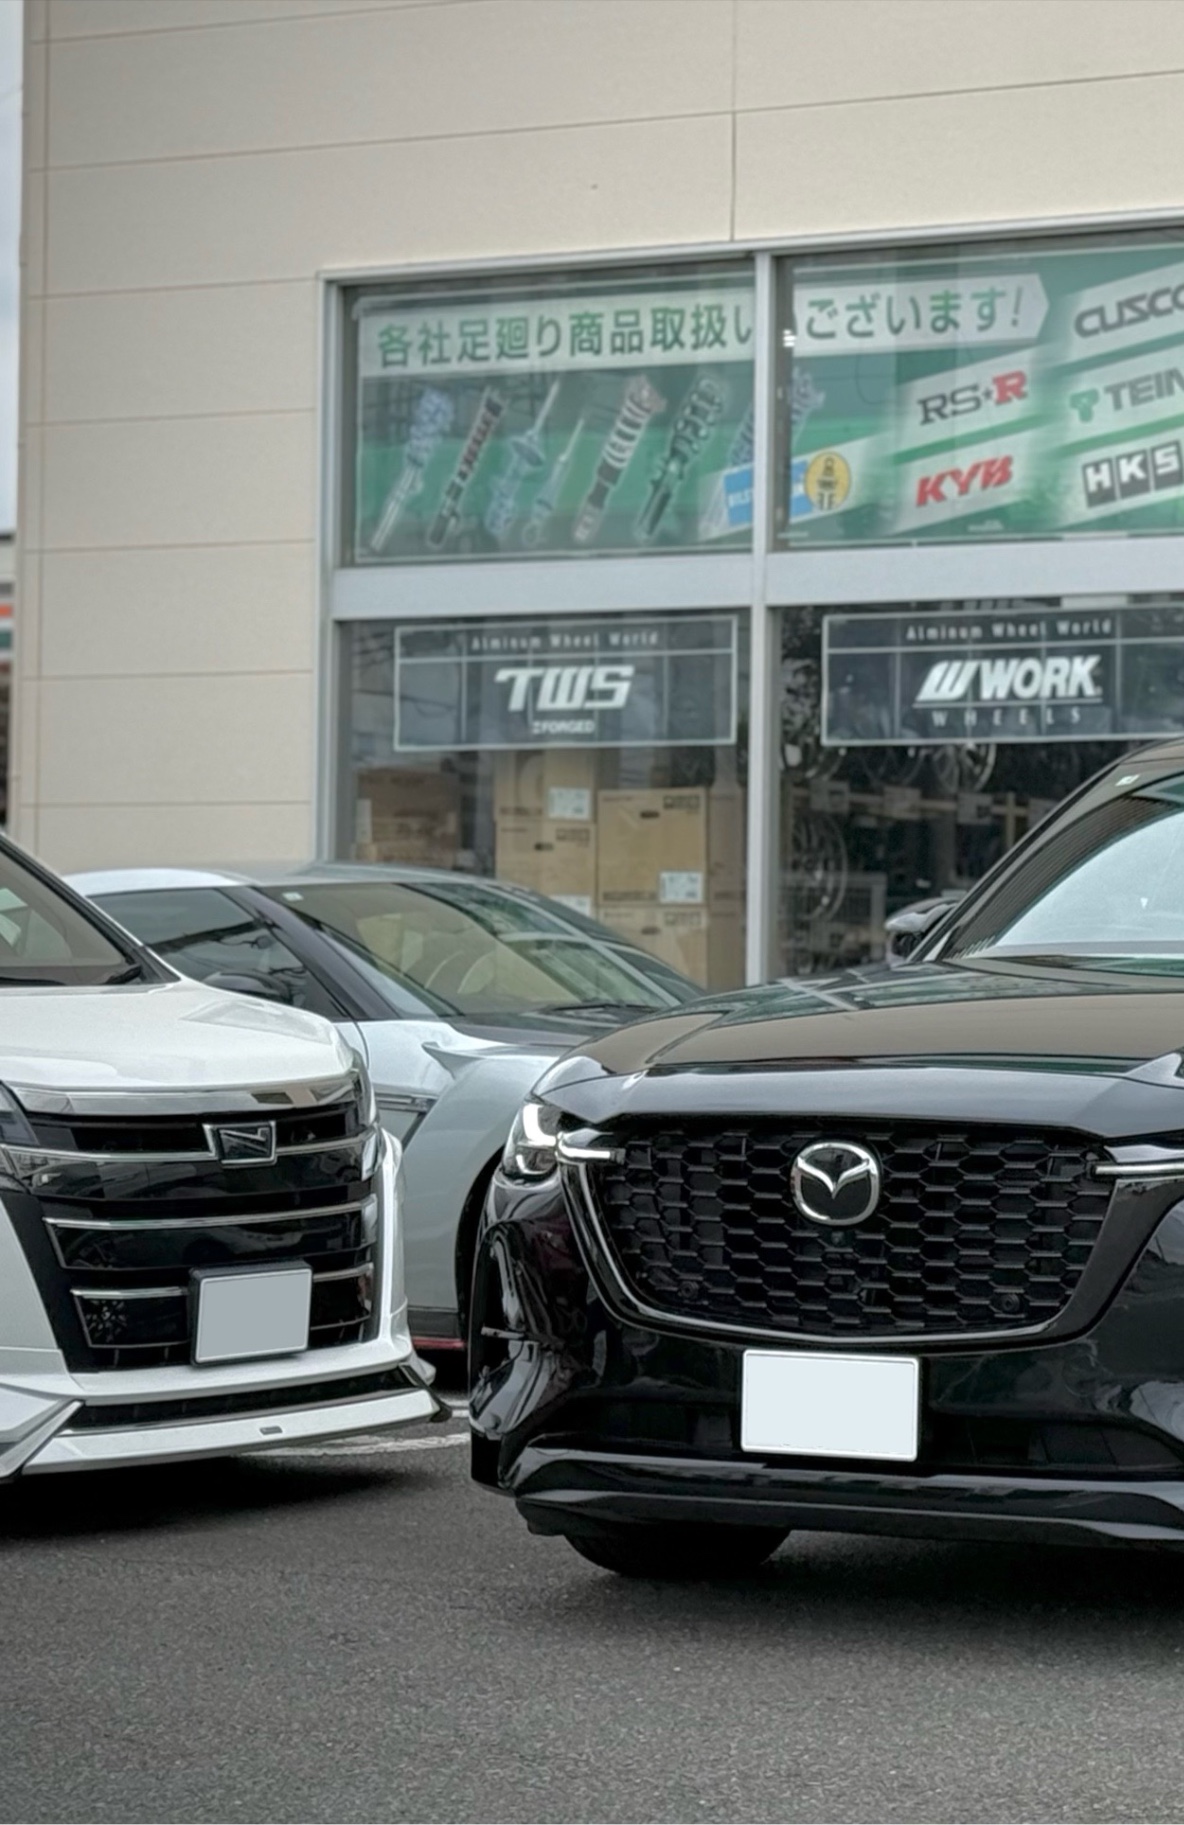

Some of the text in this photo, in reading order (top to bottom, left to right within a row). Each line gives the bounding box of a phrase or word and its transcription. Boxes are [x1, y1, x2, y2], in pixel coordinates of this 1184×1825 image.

[915, 455, 1014, 508] KYB
[1084, 445, 1182, 497] HKS
[495, 664, 635, 712] TWS
[980, 654, 1102, 701] WORK
[931, 705, 1081, 727] WHEELS
